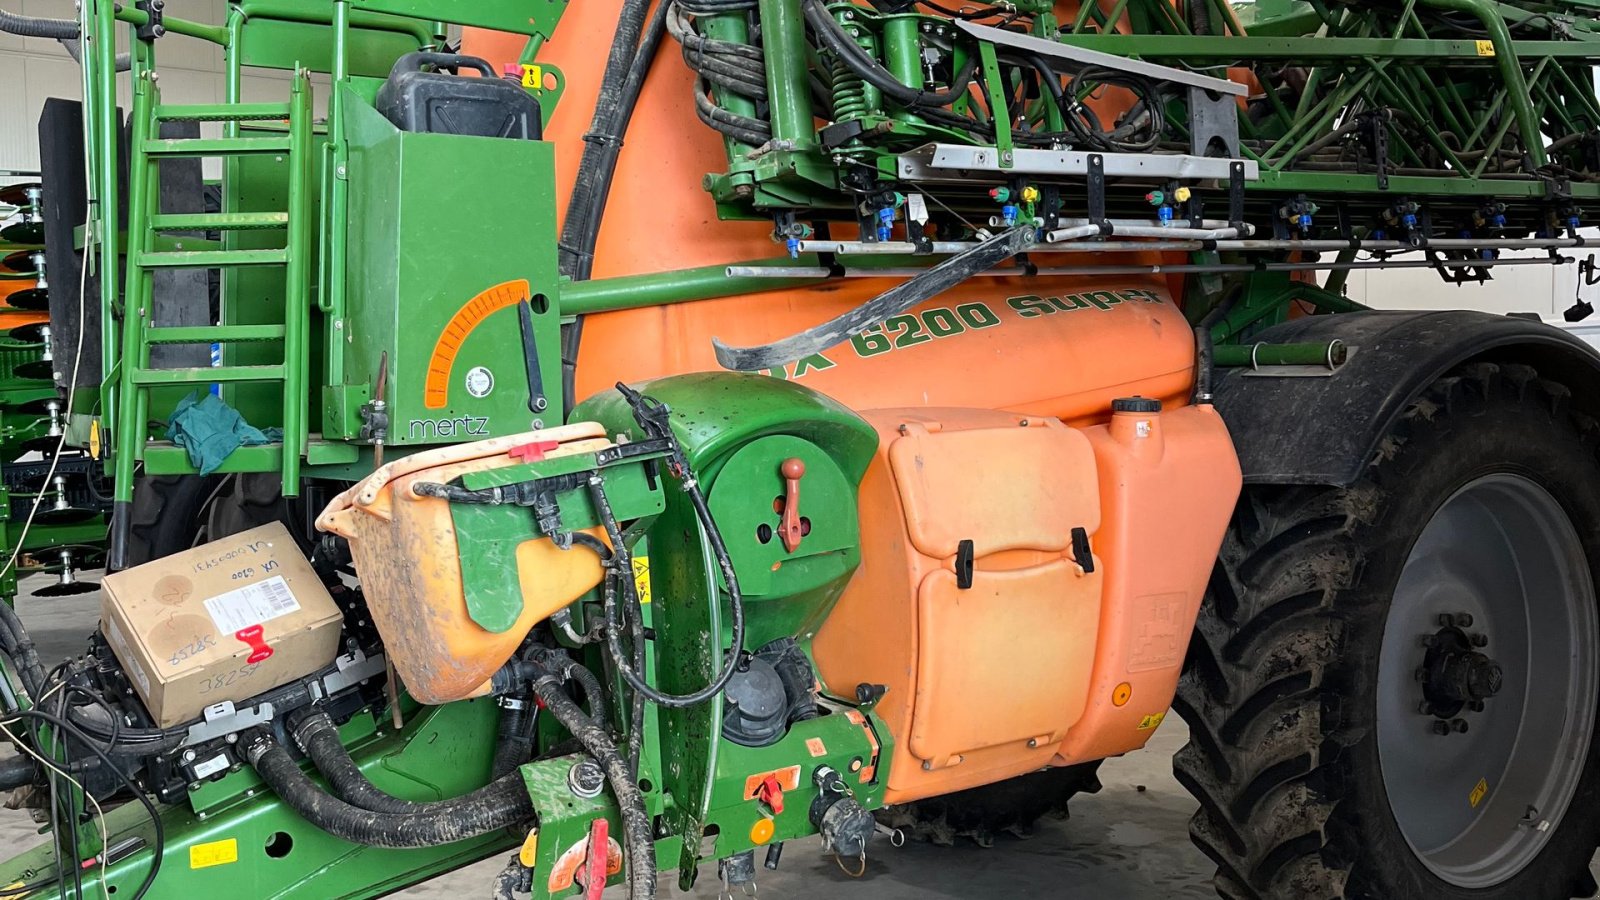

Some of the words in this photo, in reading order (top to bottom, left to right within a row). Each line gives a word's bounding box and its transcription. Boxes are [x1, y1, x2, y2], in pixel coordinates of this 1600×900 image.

[850, 302, 1002, 358] 6200
[1006, 288, 1164, 318] Super
[409, 414, 490, 439] mertz
